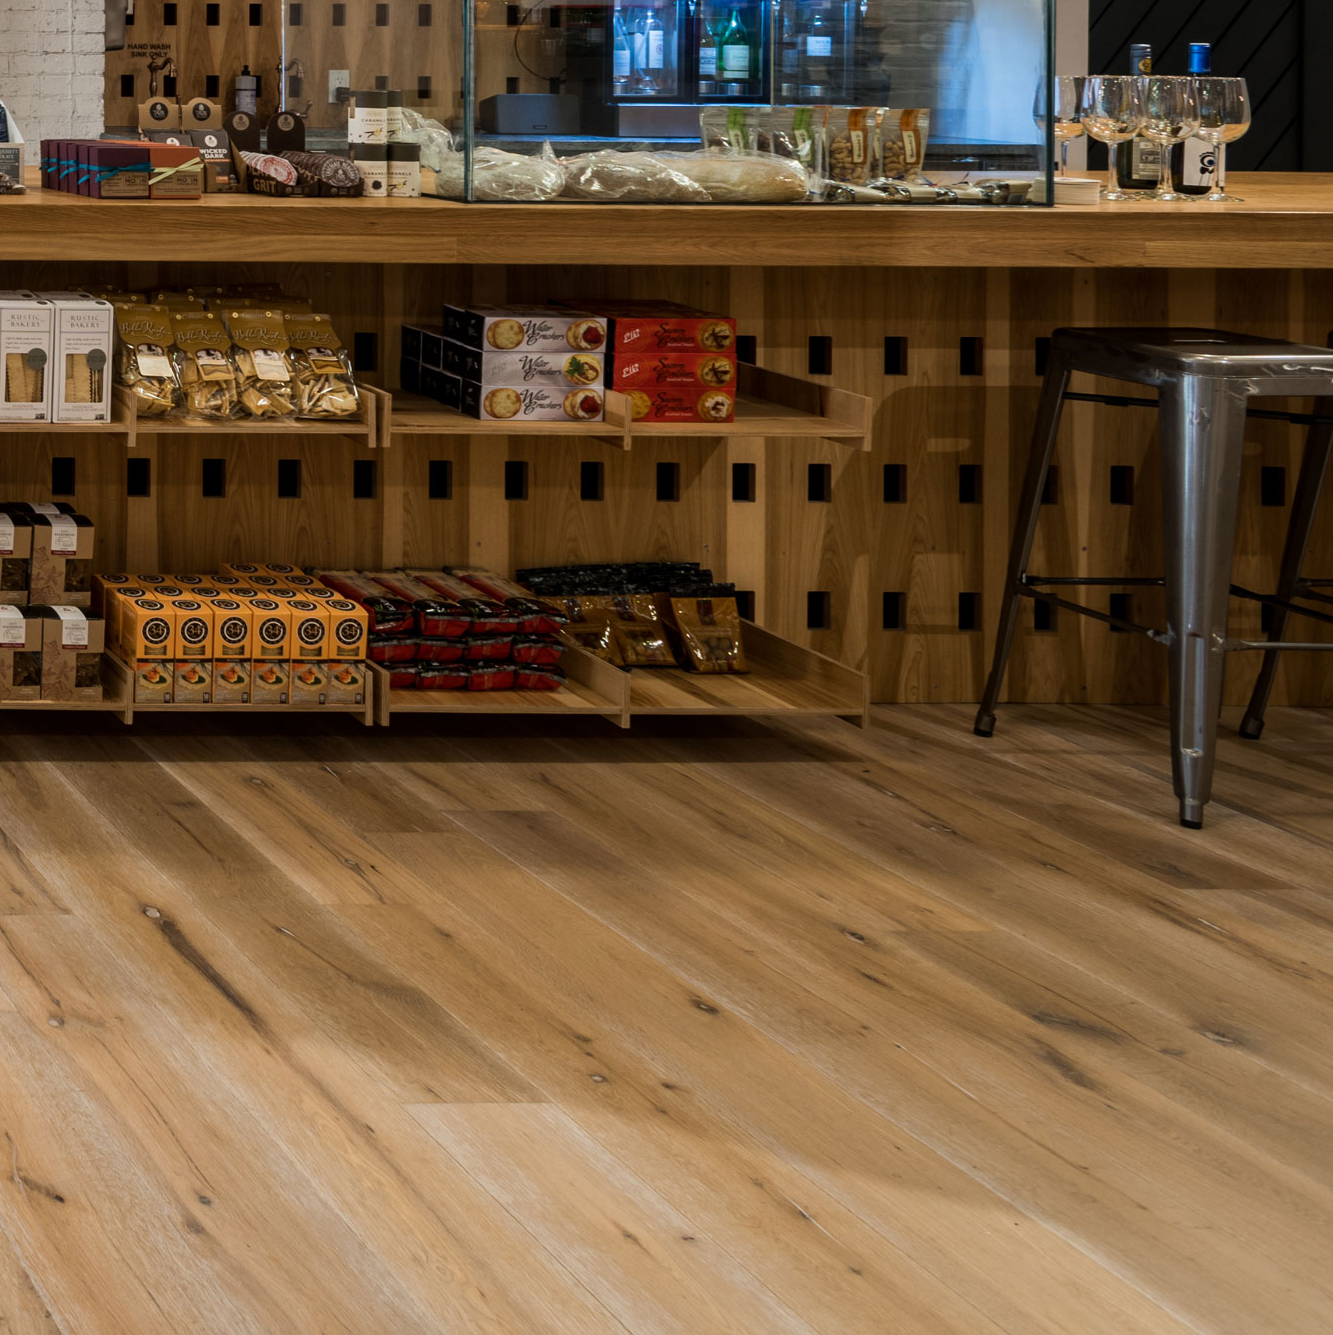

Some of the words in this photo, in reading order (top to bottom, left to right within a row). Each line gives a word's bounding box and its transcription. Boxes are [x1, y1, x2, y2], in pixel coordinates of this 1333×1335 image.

[253, 179, 277, 193] GRIT
[523, 320, 553, 335] Water
[526, 332, 565, 346] Crackers
[519, 355, 550, 370] Water
[523, 367, 562, 382] Crackers
[520, 389, 551, 404] Water
[523, 401, 562, 415] Crackers
